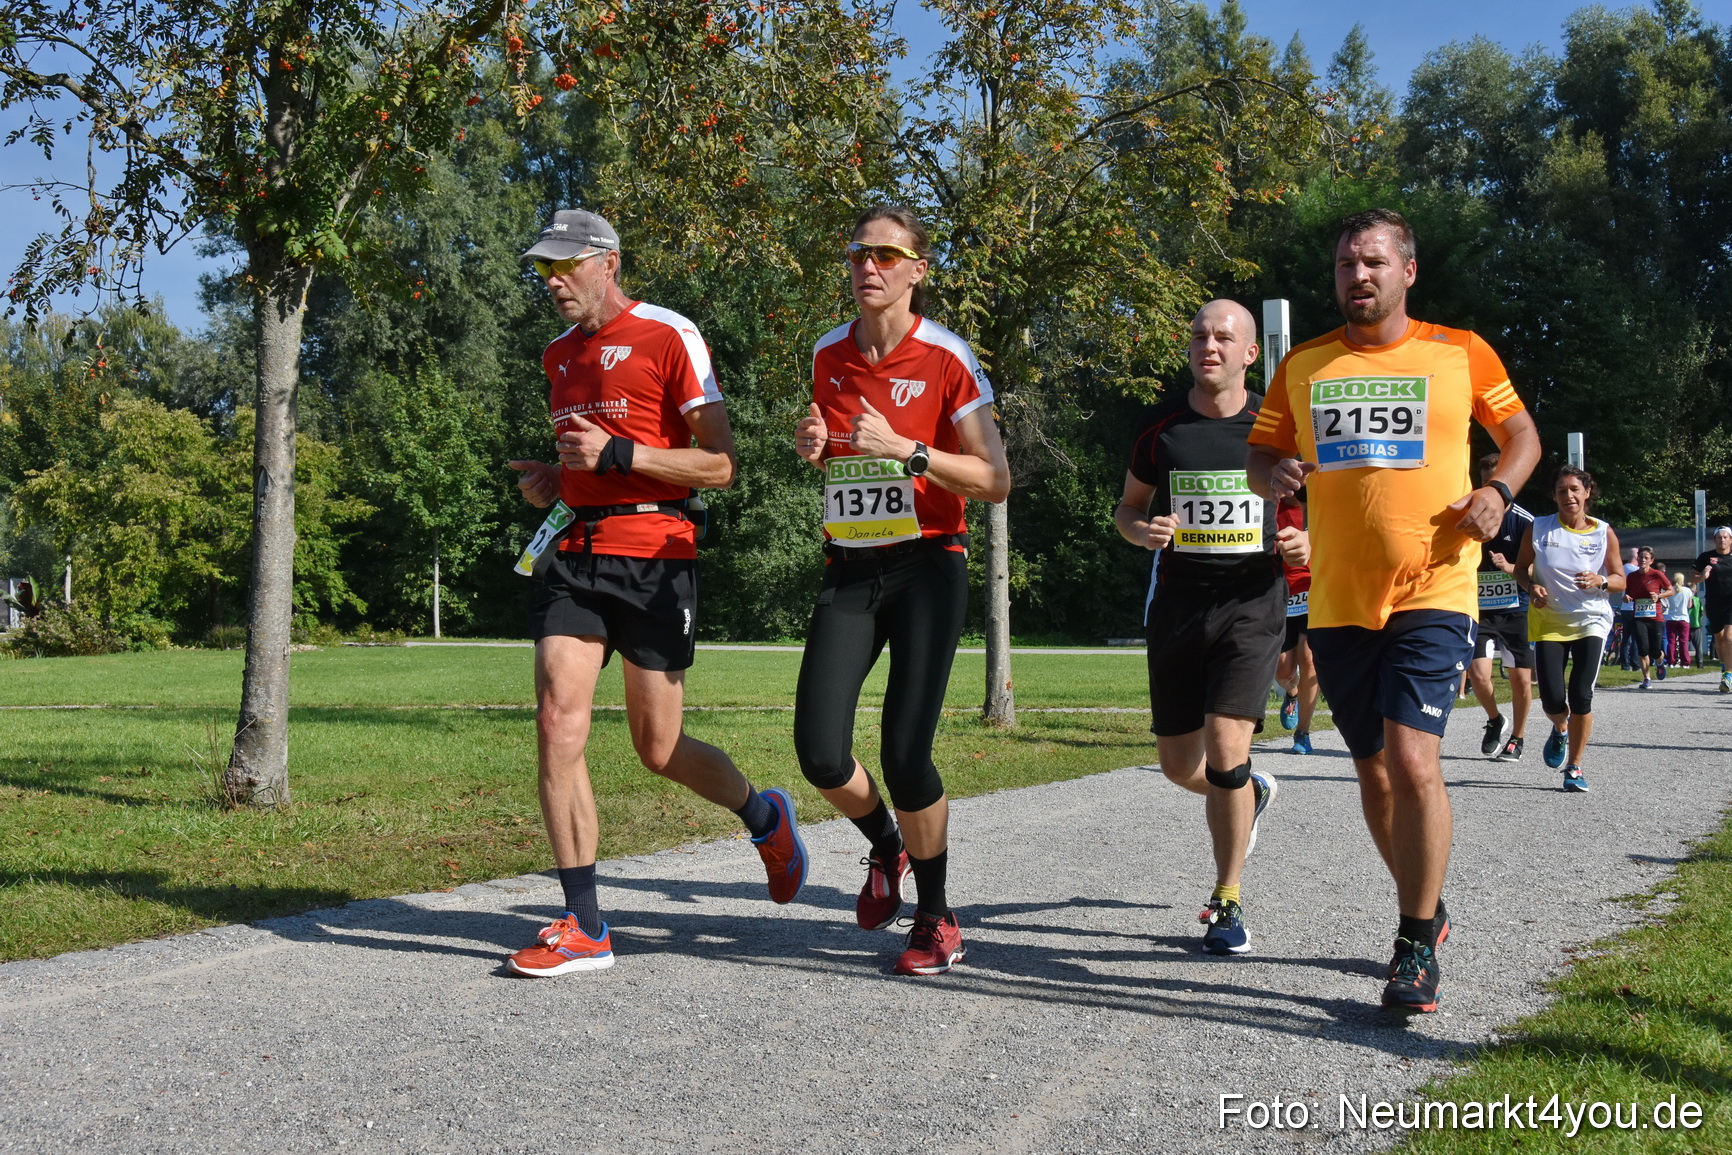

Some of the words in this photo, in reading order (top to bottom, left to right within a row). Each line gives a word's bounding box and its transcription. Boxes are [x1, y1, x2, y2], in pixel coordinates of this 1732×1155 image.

[1320, 380, 1417, 401] BOCK
[595, 398, 628, 408] WALTER
[1324, 406, 1413, 437] 2159
[1337, 443, 1398, 458] TOBIAS
[829, 459, 904, 482] BOCK
[1177, 474, 1251, 493] BOCK
[833, 486, 904, 517] 1378
[1182, 500, 1250, 525] 1321
[1181, 532, 1254, 543] BERNHARD
[1478, 583, 1512, 597] 2503
[1420, 703, 1443, 718] JAKO
